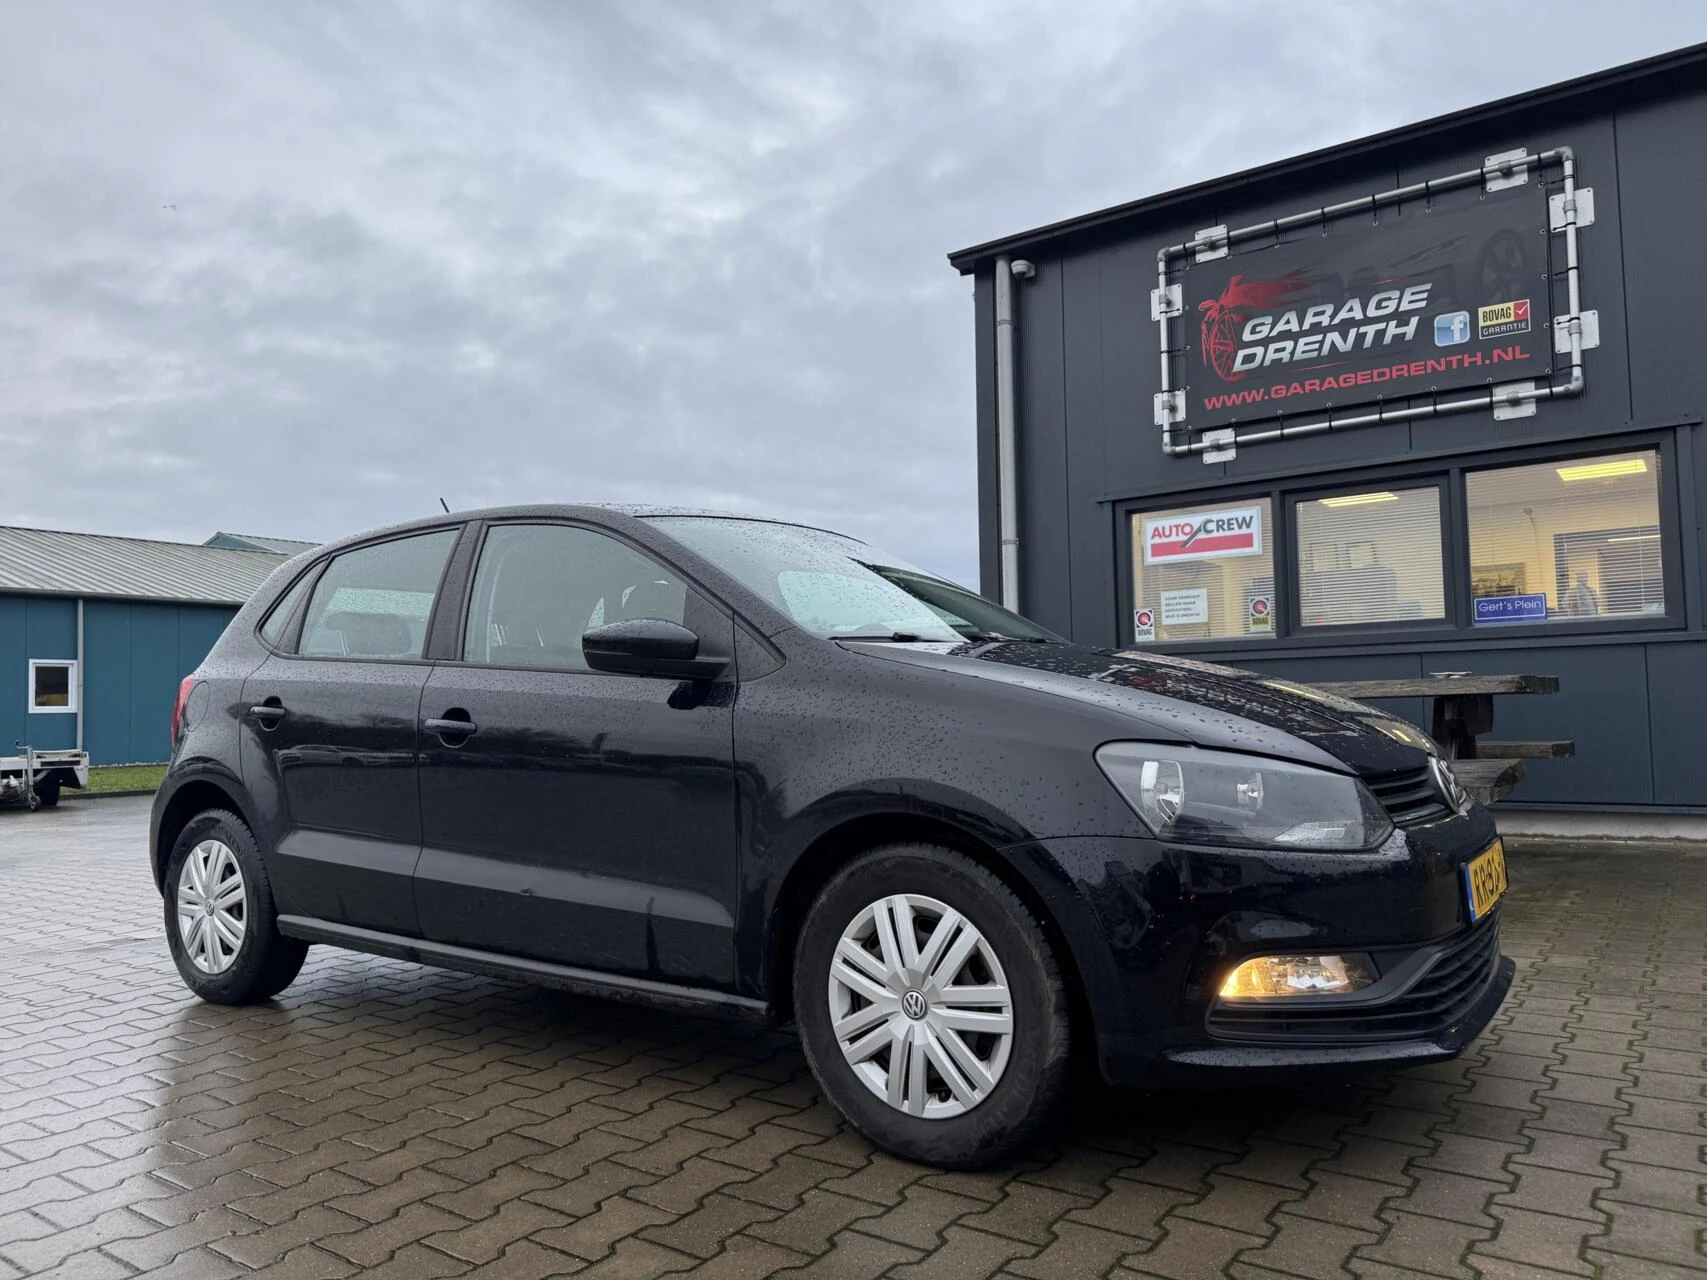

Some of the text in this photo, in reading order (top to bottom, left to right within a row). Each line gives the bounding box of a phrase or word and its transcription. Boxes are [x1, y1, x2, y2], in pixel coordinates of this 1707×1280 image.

[1241, 283, 1432, 342] GARAGE
[1482, 306, 1512, 323] BOVAG
[1483, 322, 1527, 335] GARANTIE
[1232, 316, 1419, 372] DRENTH
[1204, 346, 1530, 411] WWW.GARAGEDRENTH.NL
[1478, 599, 1542, 612] Gert's Plein
